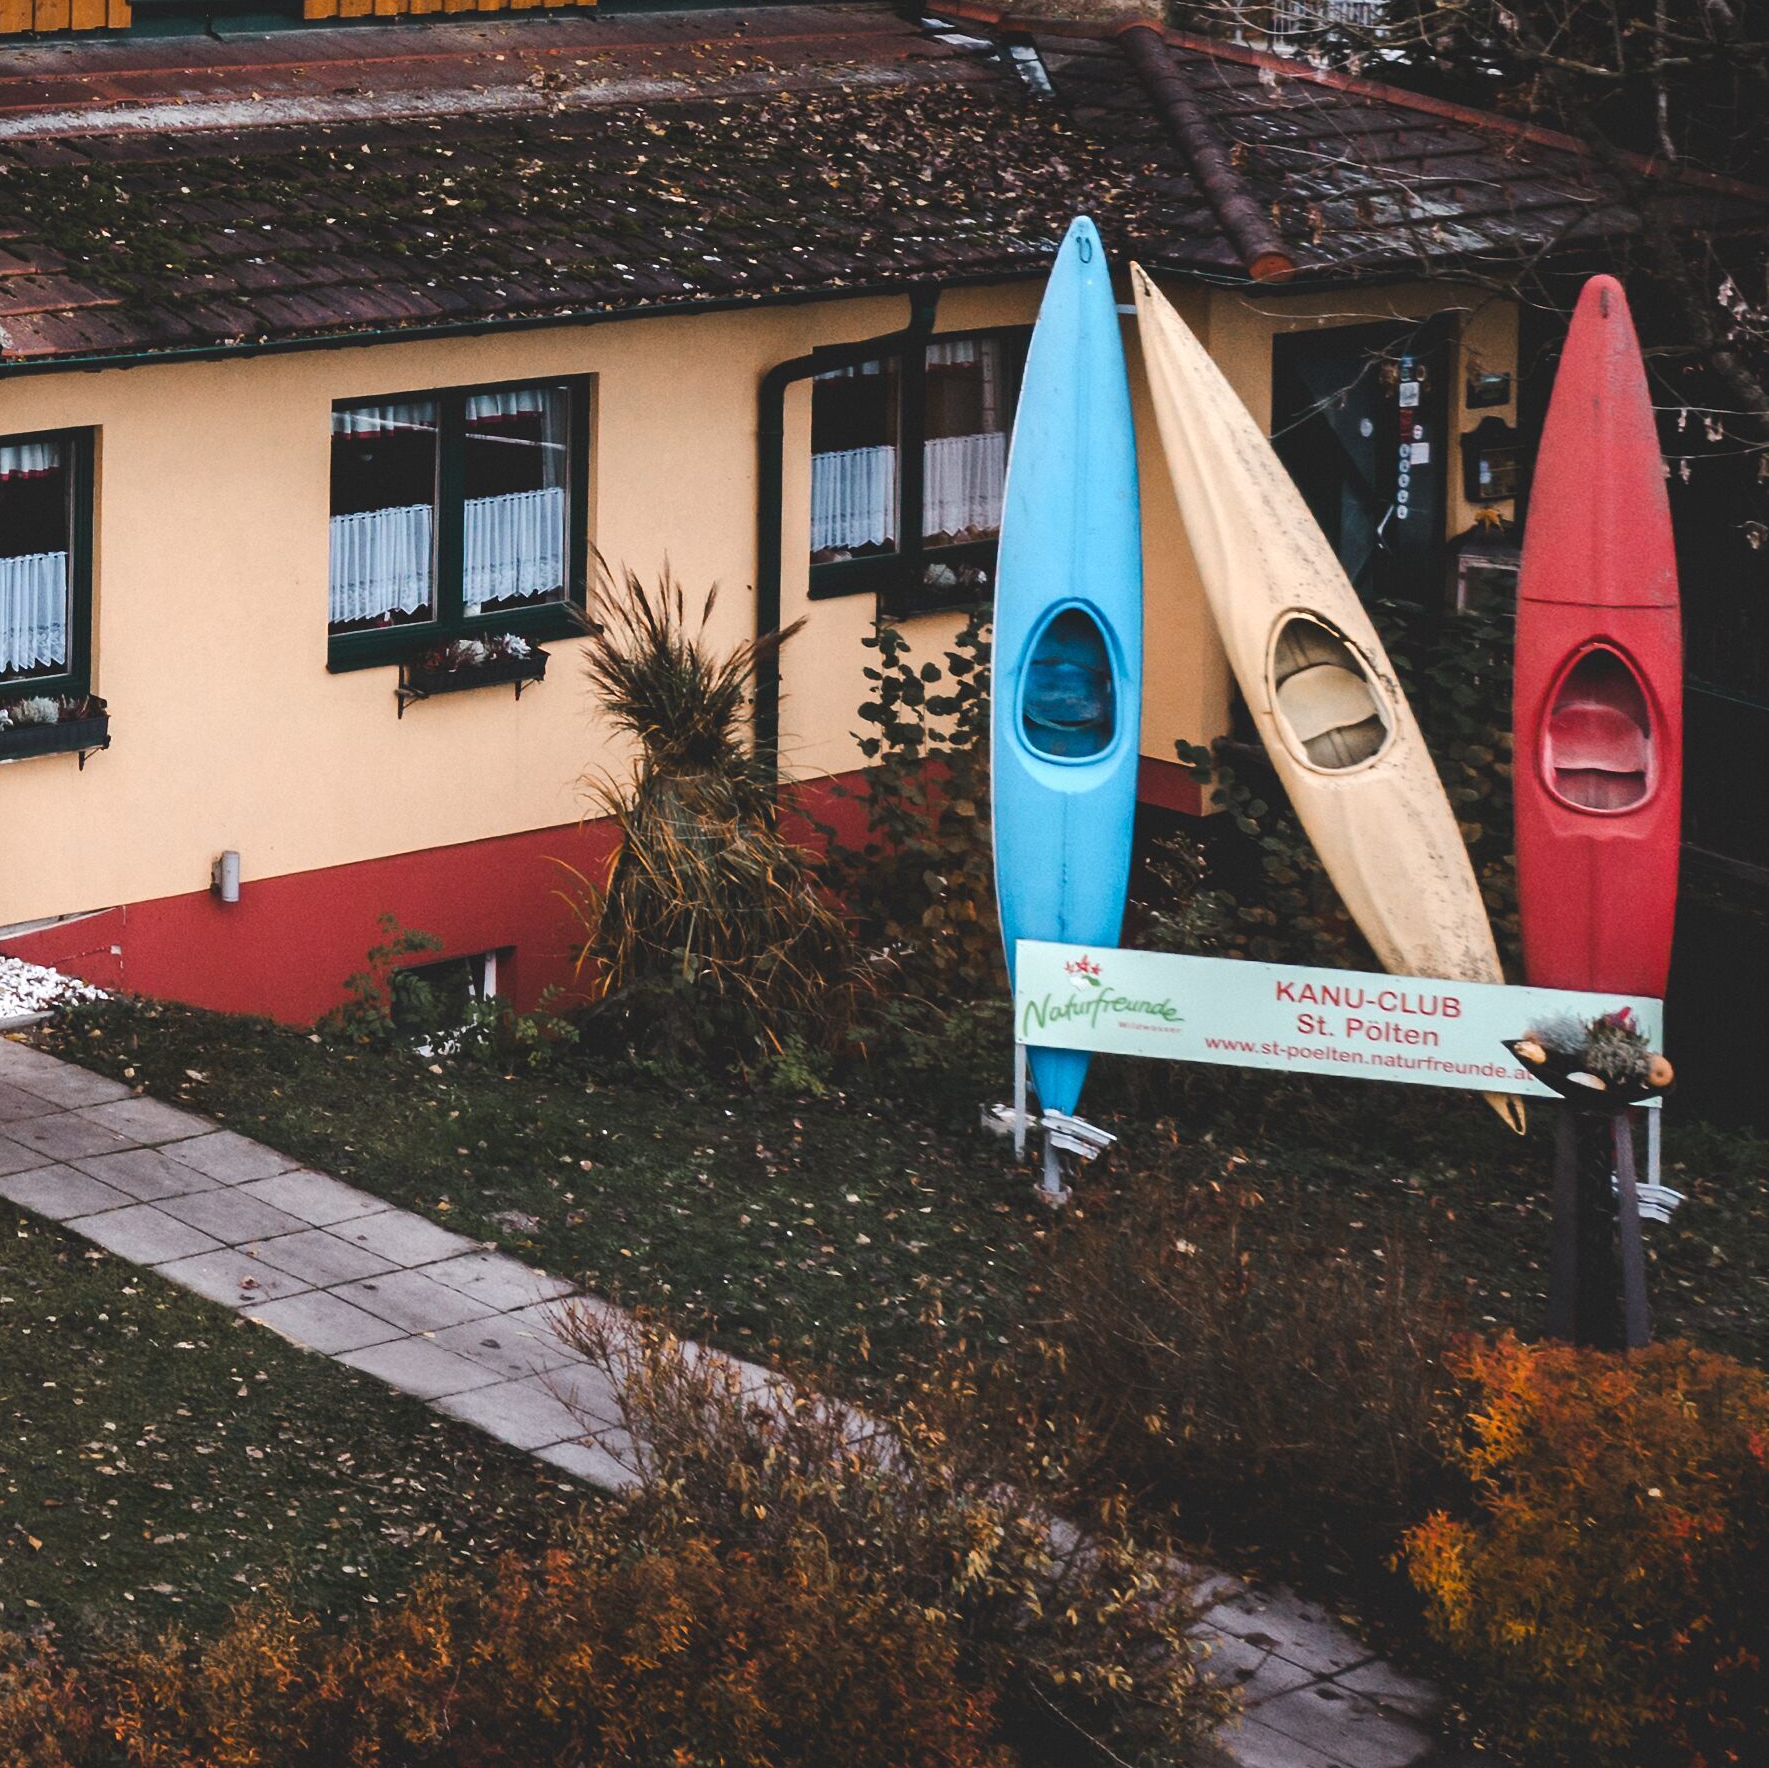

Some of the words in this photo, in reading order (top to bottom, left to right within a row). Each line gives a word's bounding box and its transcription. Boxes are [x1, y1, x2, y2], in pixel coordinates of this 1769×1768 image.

[1023, 987, 1185, 1036] Naturfreunde
[1275, 980, 1462, 1018] KANU-CLUB
[1296, 1013, 1334, 1036] St.
[1345, 1017, 1439, 1047] Pölten
